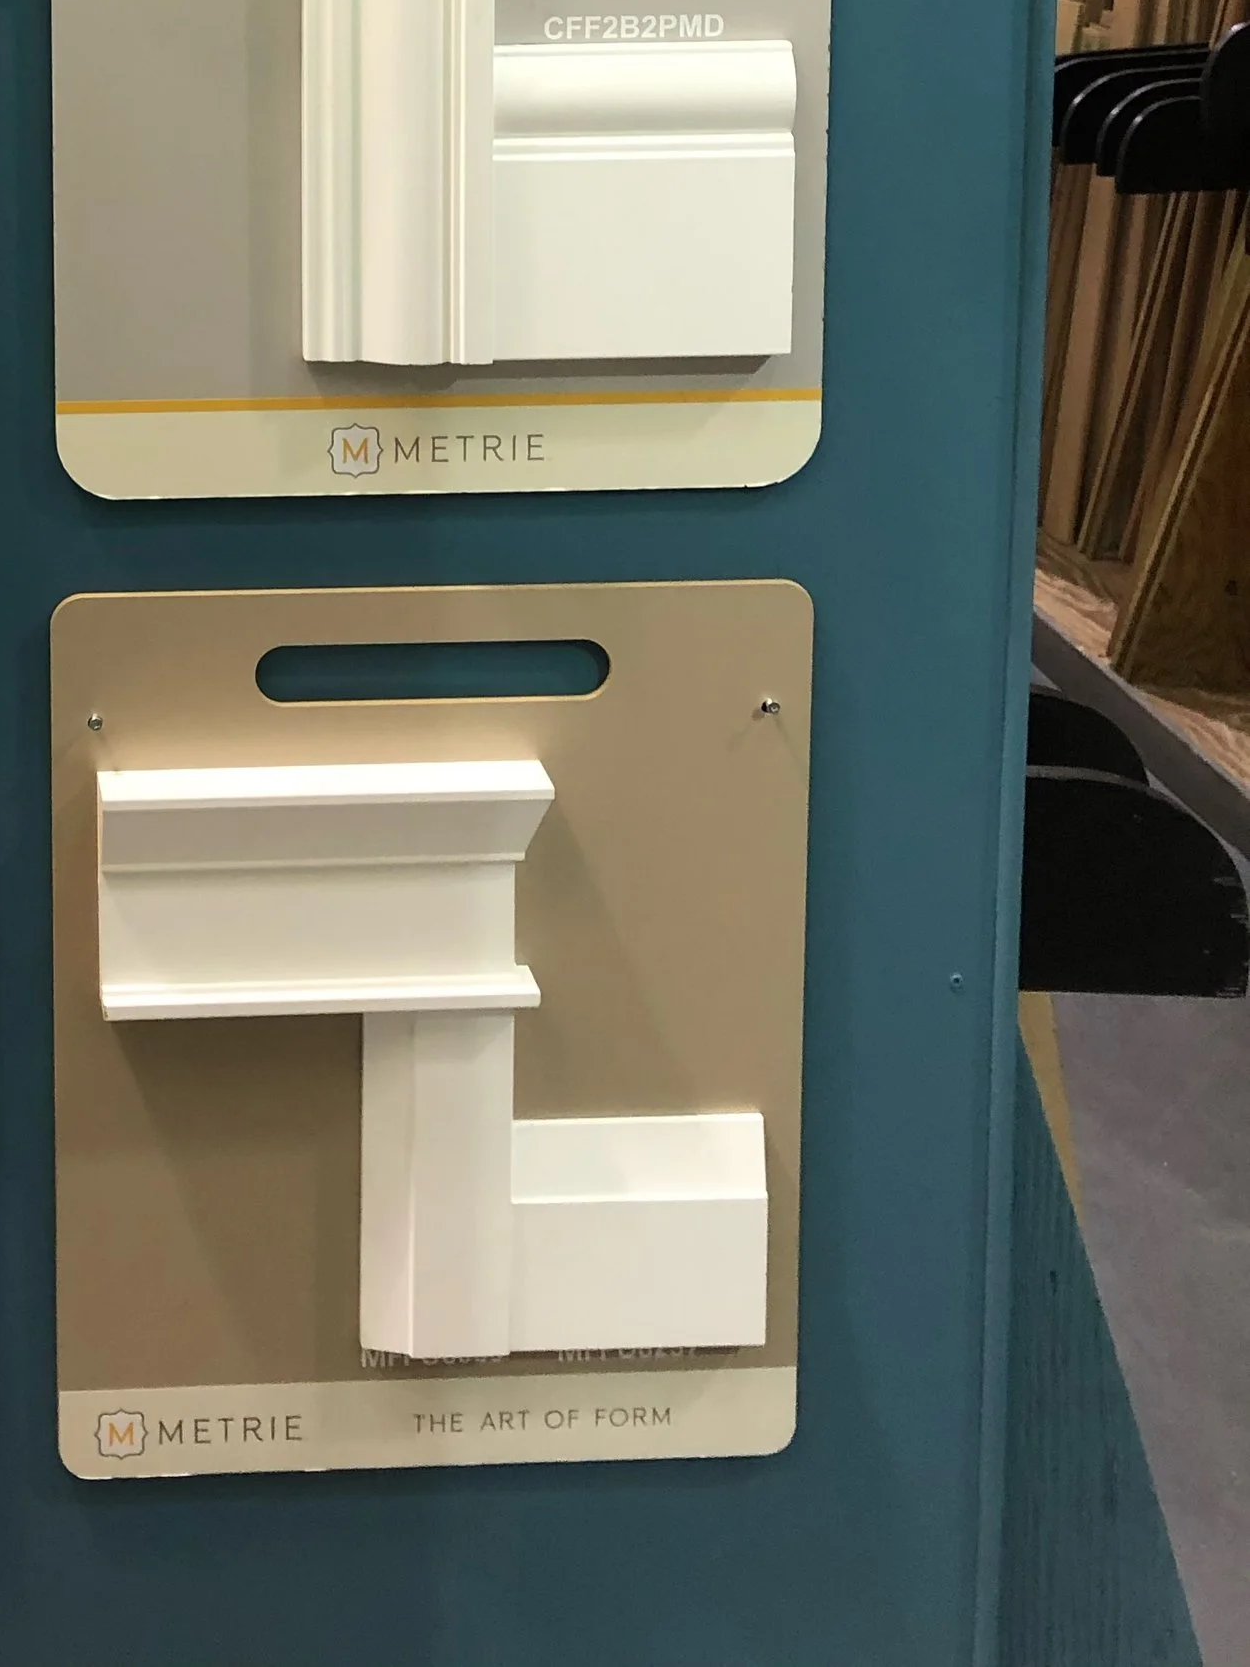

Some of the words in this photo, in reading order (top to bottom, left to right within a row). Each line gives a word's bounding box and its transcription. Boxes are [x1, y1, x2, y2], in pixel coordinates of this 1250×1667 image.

[543, 13, 724, 41] CFF2B2PMD
[341, 437, 370, 465] M
[393, 434, 545, 464] METRIE
[108, 1421, 135, 1447] M
[158, 1415, 303, 1445] METRIE
[413, 1412, 464, 1434] THE
[480, 1410, 530, 1432] ART
[544, 1409, 579, 1430] OF
[595, 1407, 671, 1428] FORM
